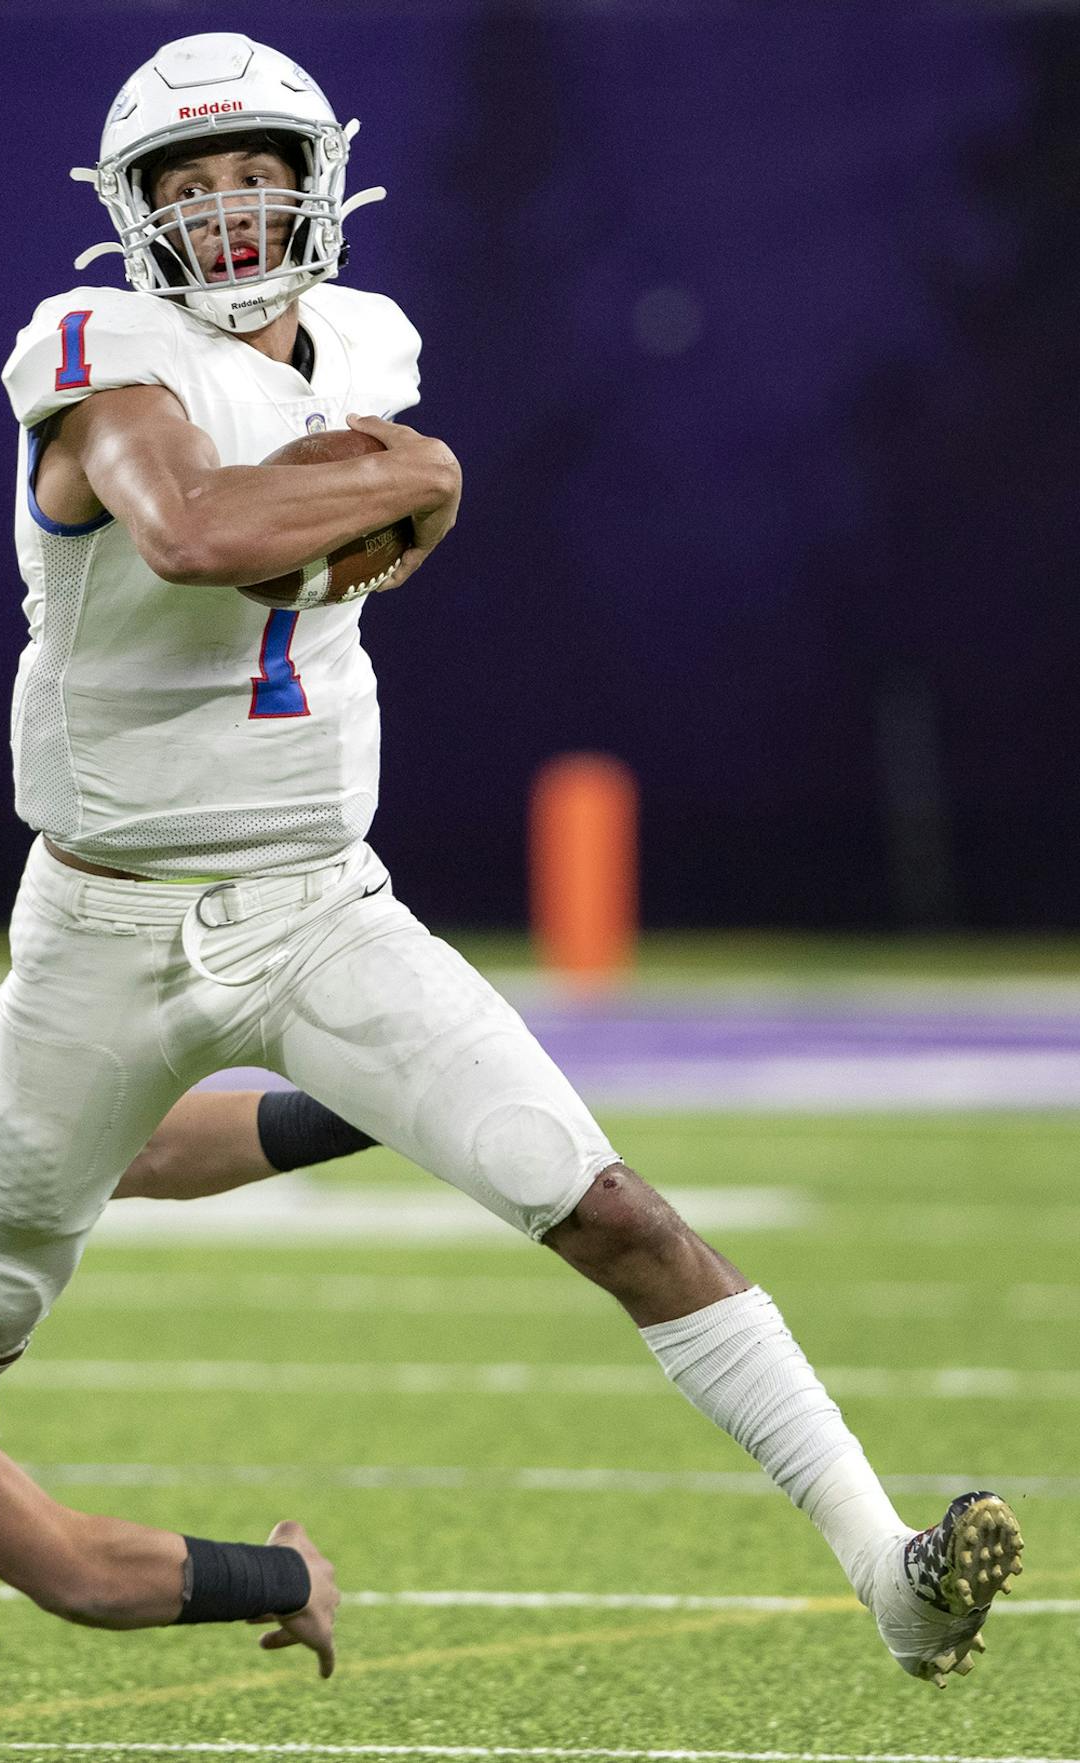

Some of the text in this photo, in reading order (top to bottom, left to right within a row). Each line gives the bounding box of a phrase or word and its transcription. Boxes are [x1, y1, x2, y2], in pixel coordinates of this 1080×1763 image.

[178, 101, 243, 119] Riddell
[231, 297, 264, 309] Riddell
[55, 310, 93, 391] 1
